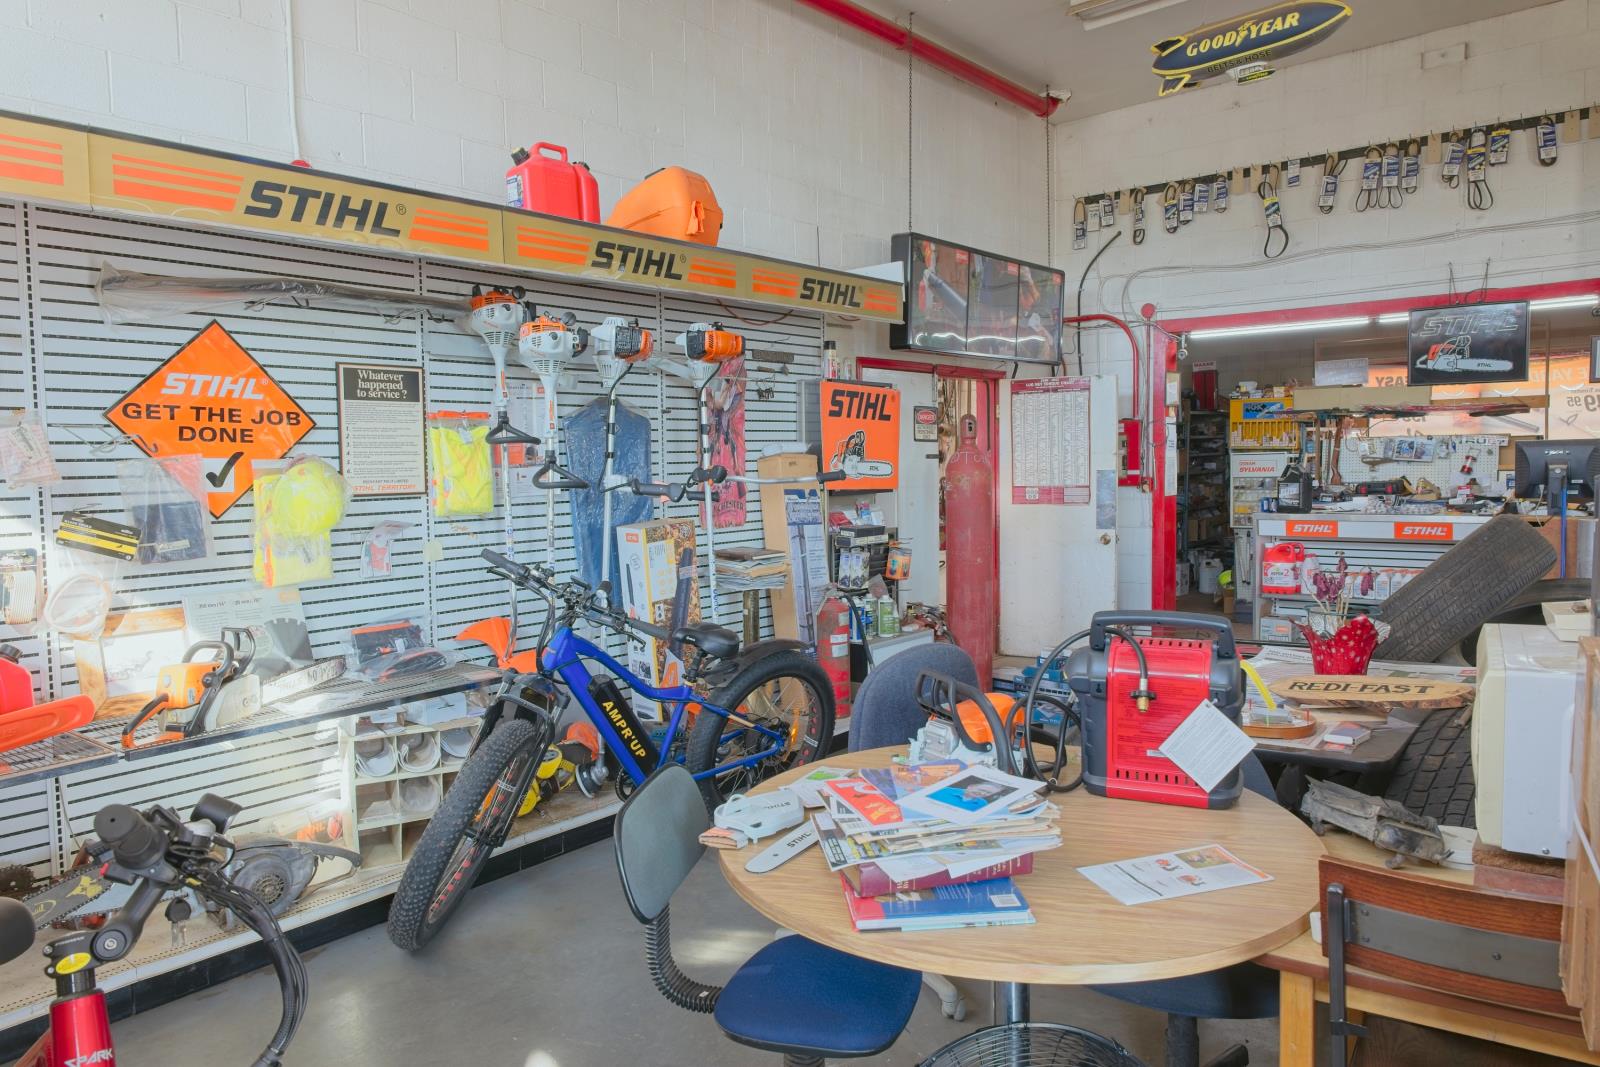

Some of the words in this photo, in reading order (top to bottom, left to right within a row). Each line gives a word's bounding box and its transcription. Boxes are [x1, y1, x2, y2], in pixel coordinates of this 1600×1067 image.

[1186, 12, 1300, 57] GOODYEAR
[1207, 60, 1235, 73] BELTS
[1245, 50, 1272, 62] HOSE
[244, 180, 401, 237] STIHL
[591, 240, 683, 281] STIHL
[800, 278, 861, 308] STIHL
[357, 369, 404, 381] Whatever
[358, 379, 404, 392] happened
[160, 373, 265, 400] STIHL
[356, 389, 367, 398] to
[368, 390, 401, 399] service
[122, 402, 181, 421] GET
[190, 405, 242, 424] THE
[250, 409, 301, 426] JOB
[828, 389, 892, 422] STIHL
[178, 425, 254, 444] DONE
[1292, 524, 1333, 533] STIHL
[1401, 526, 1446, 536] STIHL
[1288, 681, 1434, 695] REDI-FAST
[602, 701, 646, 757] AMPR'UP
[786, 832, 812, 848] STIHL
[64, 1048, 113, 1067] SPARK
